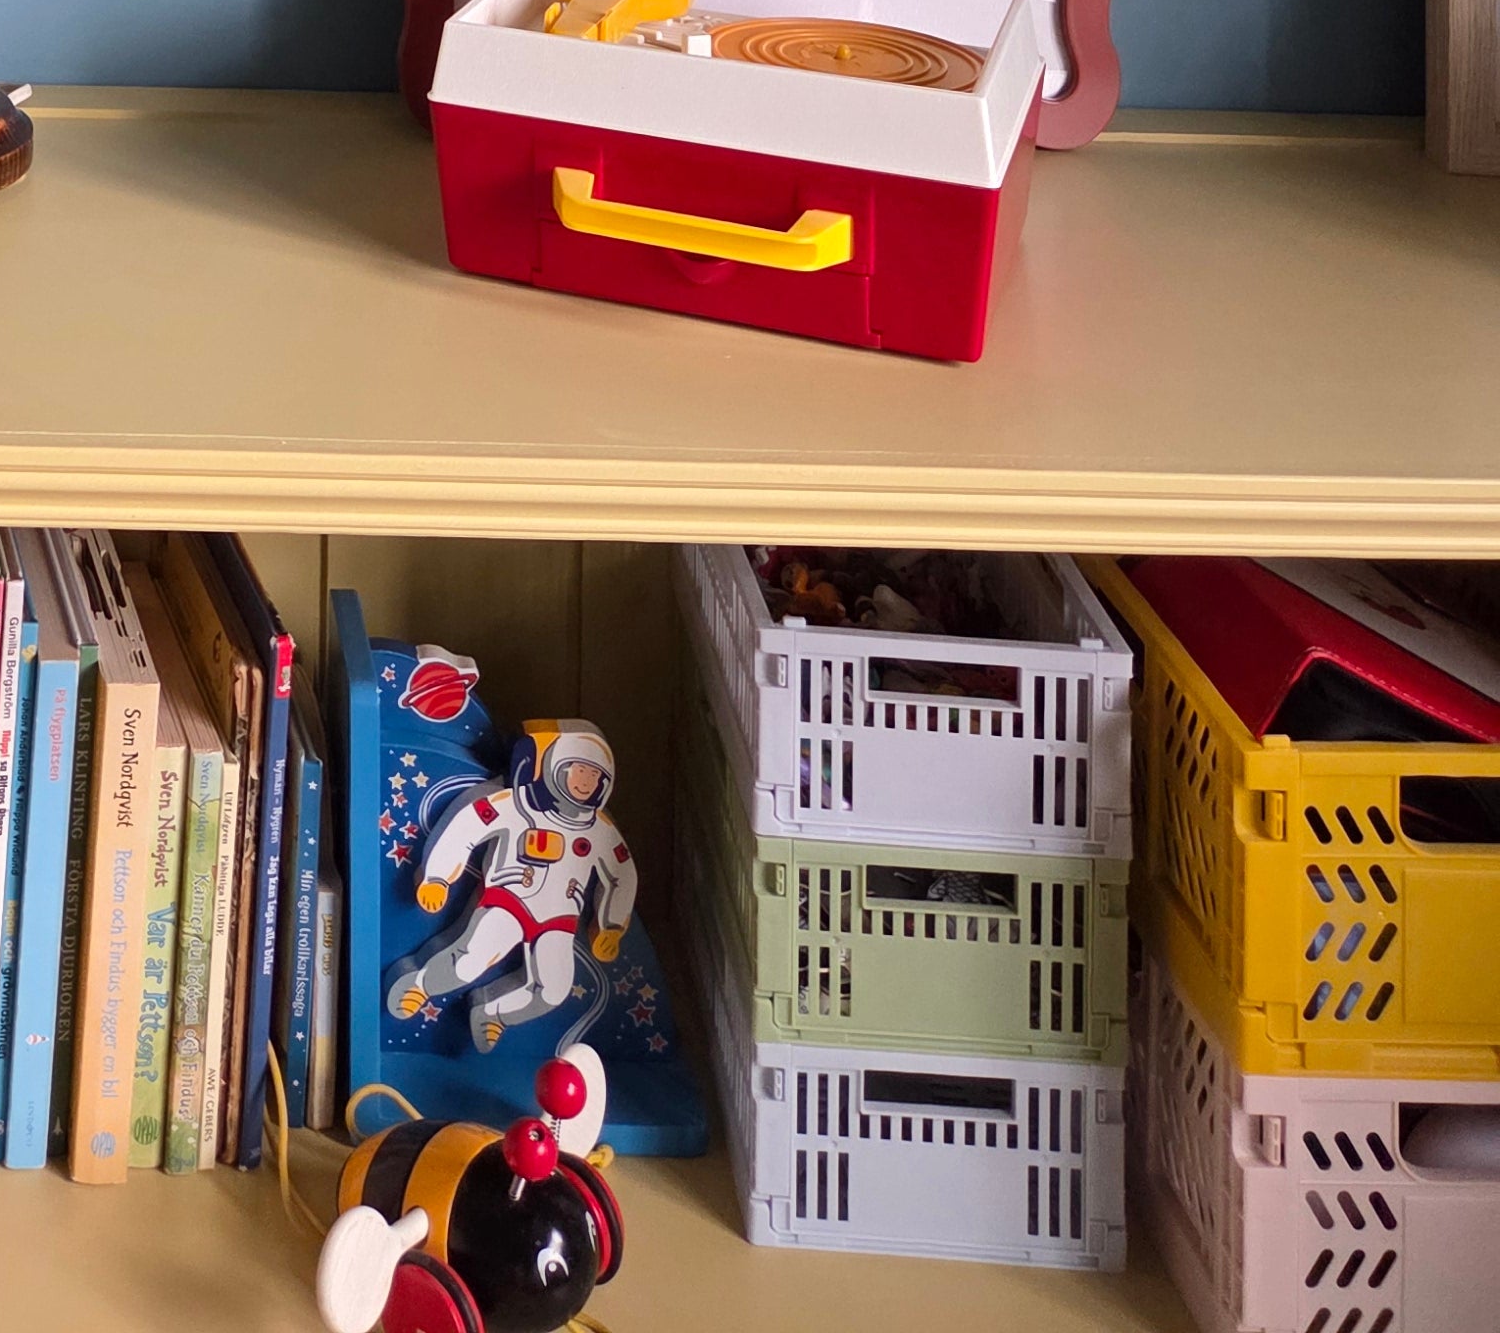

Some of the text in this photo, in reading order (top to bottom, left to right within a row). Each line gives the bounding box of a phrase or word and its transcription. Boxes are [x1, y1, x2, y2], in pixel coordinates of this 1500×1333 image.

[2, 617, 19, 719] Gunilla Bergström
[49, 689, 67, 781] På flygplatsen
[199, 761, 212, 789] Sven
[223, 792, 234, 805] Ulf
[57, 697, 92, 1042] LARS KLINTING FÖRSTA DJURBOKEN
[101, 708, 141, 1098] Sven Nordqvist Pettson och Findus bygger en bil
[217, 855, 230, 896] Påhittiga
[134, 771, 179, 1082] Sven Nordqvist Var är Pettson?
[292, 870, 314, 1017] Min egen trollkarlssaga
